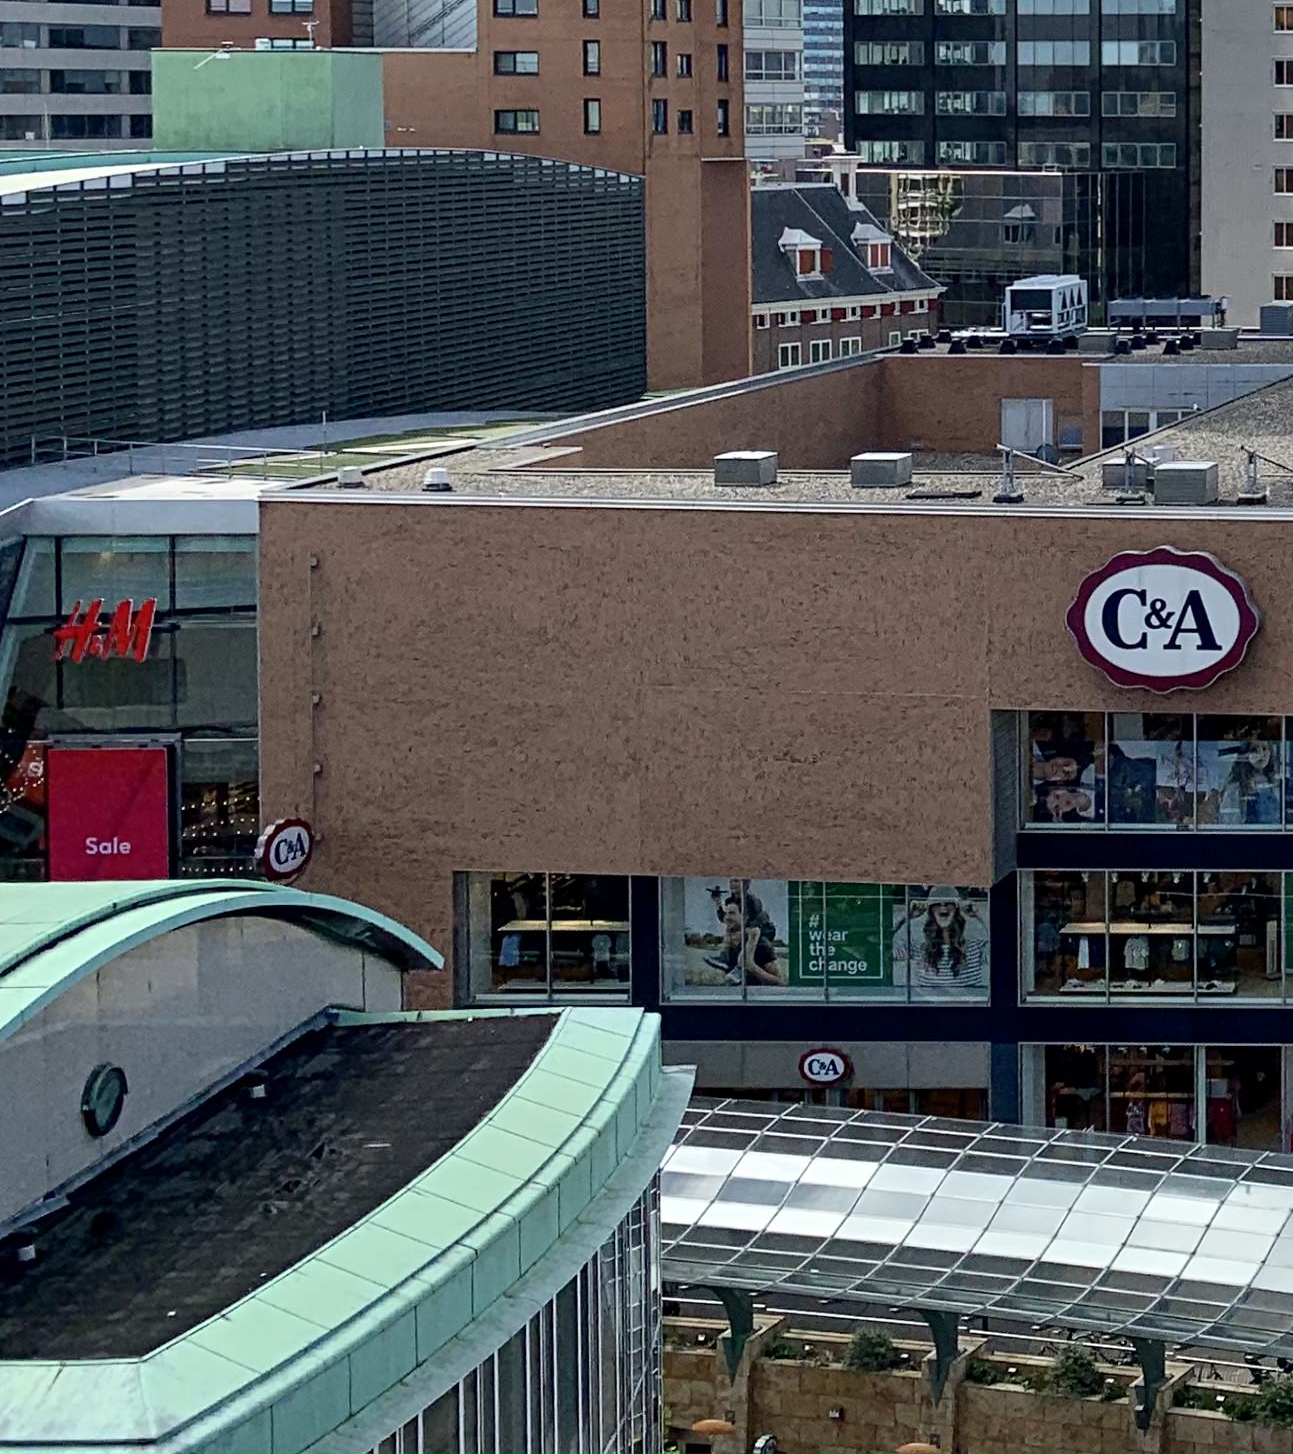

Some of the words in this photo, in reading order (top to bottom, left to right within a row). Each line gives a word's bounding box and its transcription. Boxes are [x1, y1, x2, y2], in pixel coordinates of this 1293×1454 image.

[1101, 588, 1223, 651] C&A
[53, 597, 157, 663] H&M
[85, 836, 131, 854] Sale
[274, 832, 306, 865] C&A
[809, 930, 848, 942] wear
[809, 941, 836, 957] the
[808, 957, 868, 975] change
[808, 1058, 840, 1076] C&A
